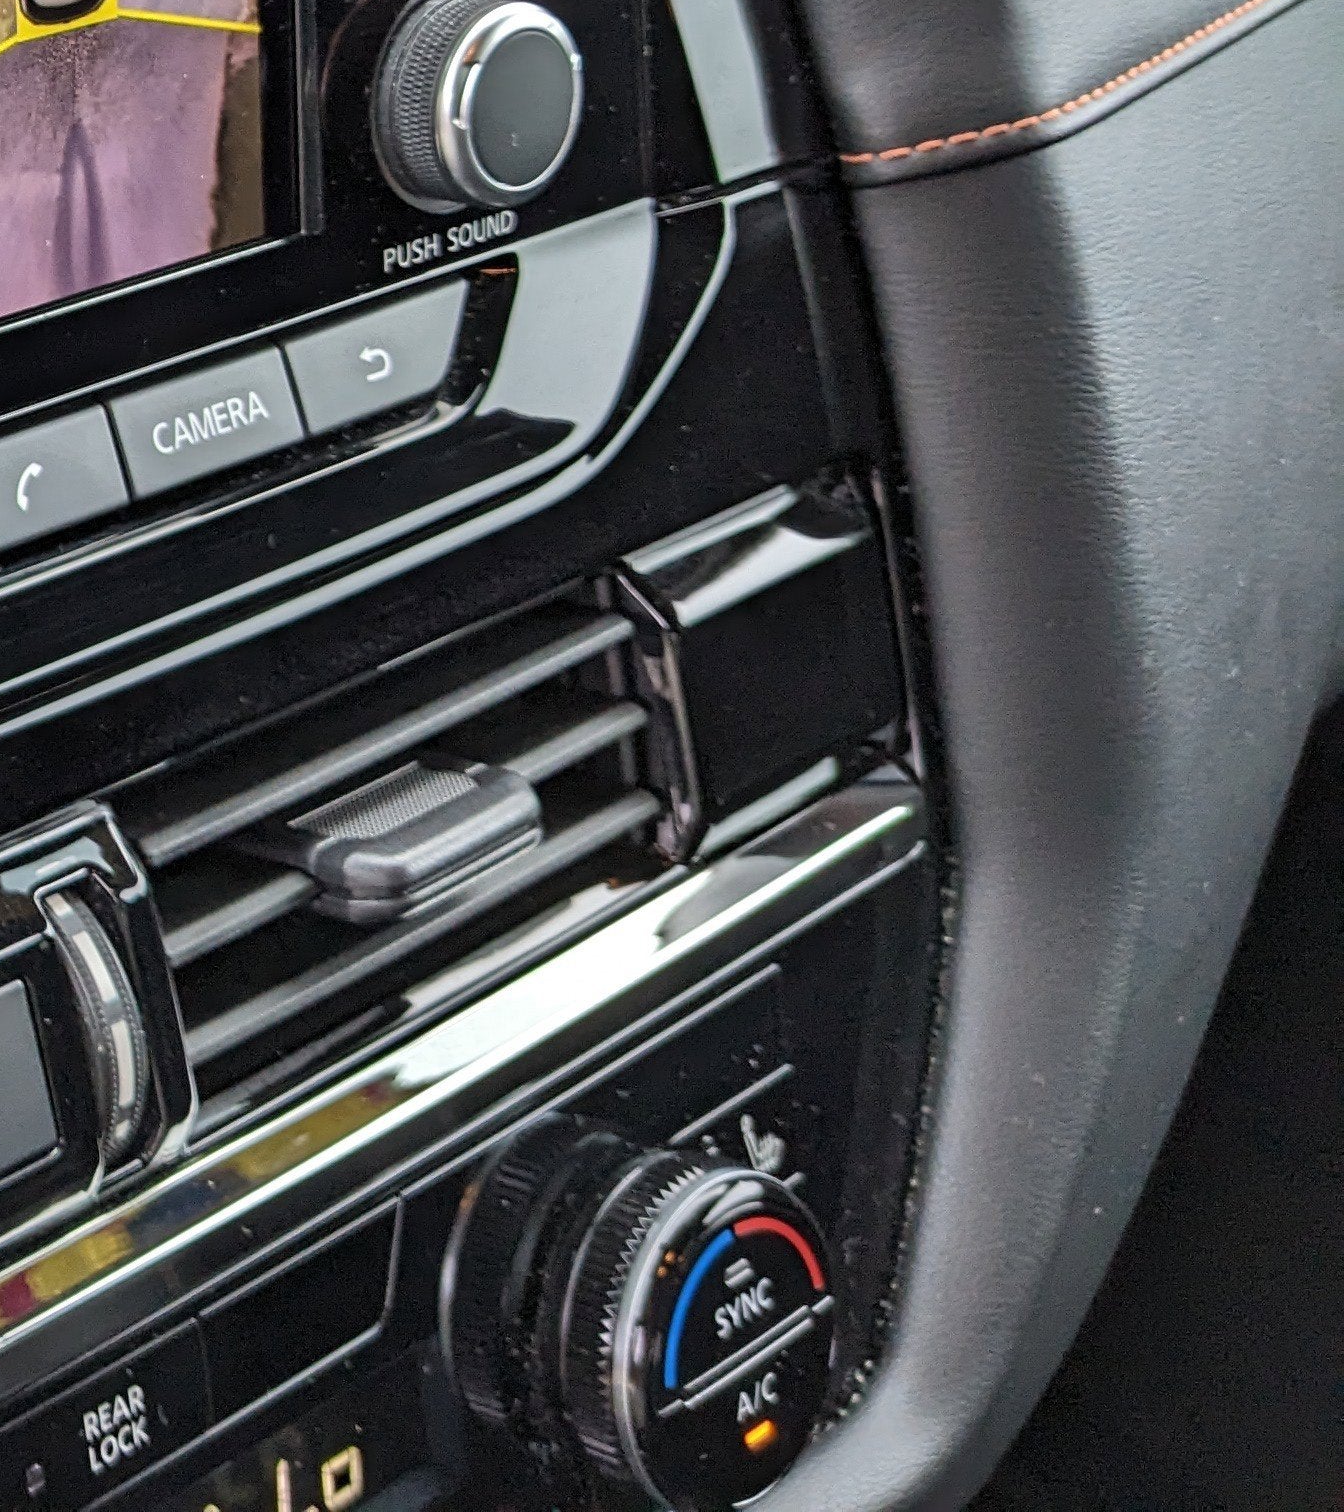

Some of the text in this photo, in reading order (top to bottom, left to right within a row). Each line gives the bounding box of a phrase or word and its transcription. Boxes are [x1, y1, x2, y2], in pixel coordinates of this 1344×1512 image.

[383, 210, 518, 272] PUSH SOUND
[152, 390, 269, 455] CAMERA
[715, 1276, 775, 1341] SYNC
[82, 1384, 146, 1444] REAR
[736, 1371, 780, 1424] A/C
[88, 1417, 151, 1476] LOCK
